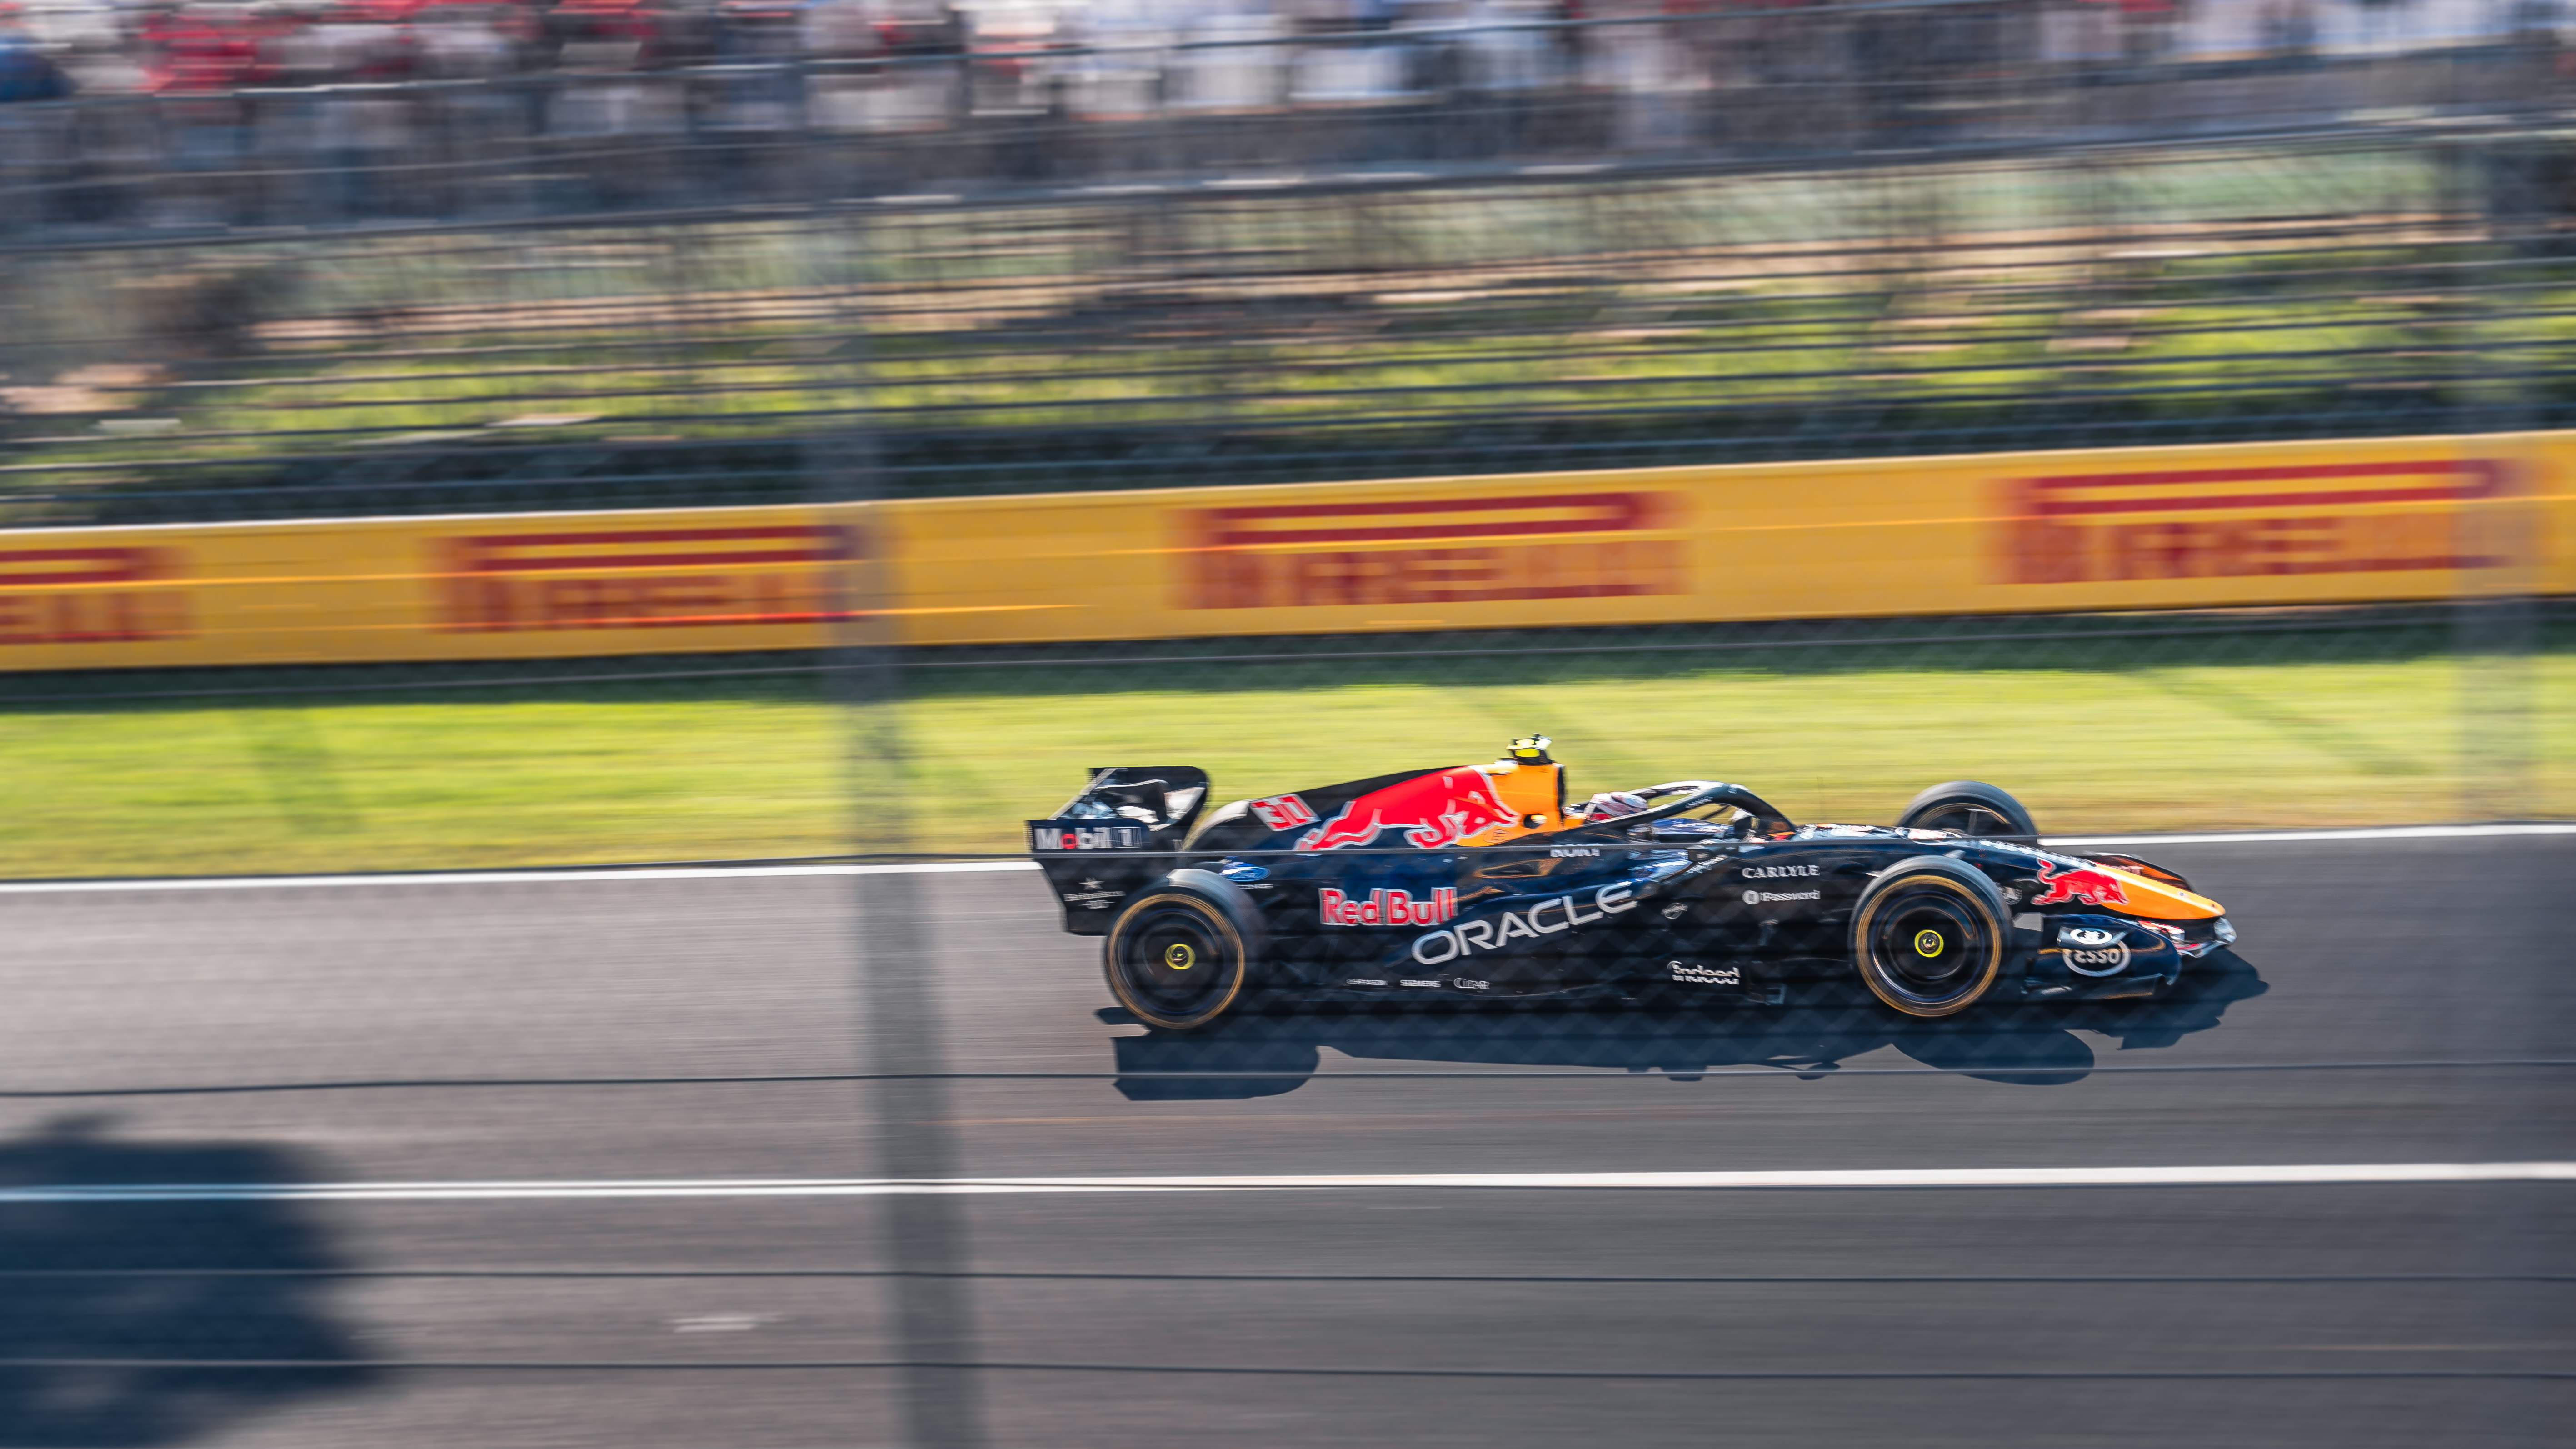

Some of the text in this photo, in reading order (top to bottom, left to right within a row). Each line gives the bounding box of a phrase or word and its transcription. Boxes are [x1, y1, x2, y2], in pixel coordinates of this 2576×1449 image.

[1033, 827, 1138, 849] Mobil 1
[1742, 865, 1820, 878] CARLYLE
[1319, 887, 1458, 926] Red Bull
[1411, 881, 1638, 964] ORACLE
